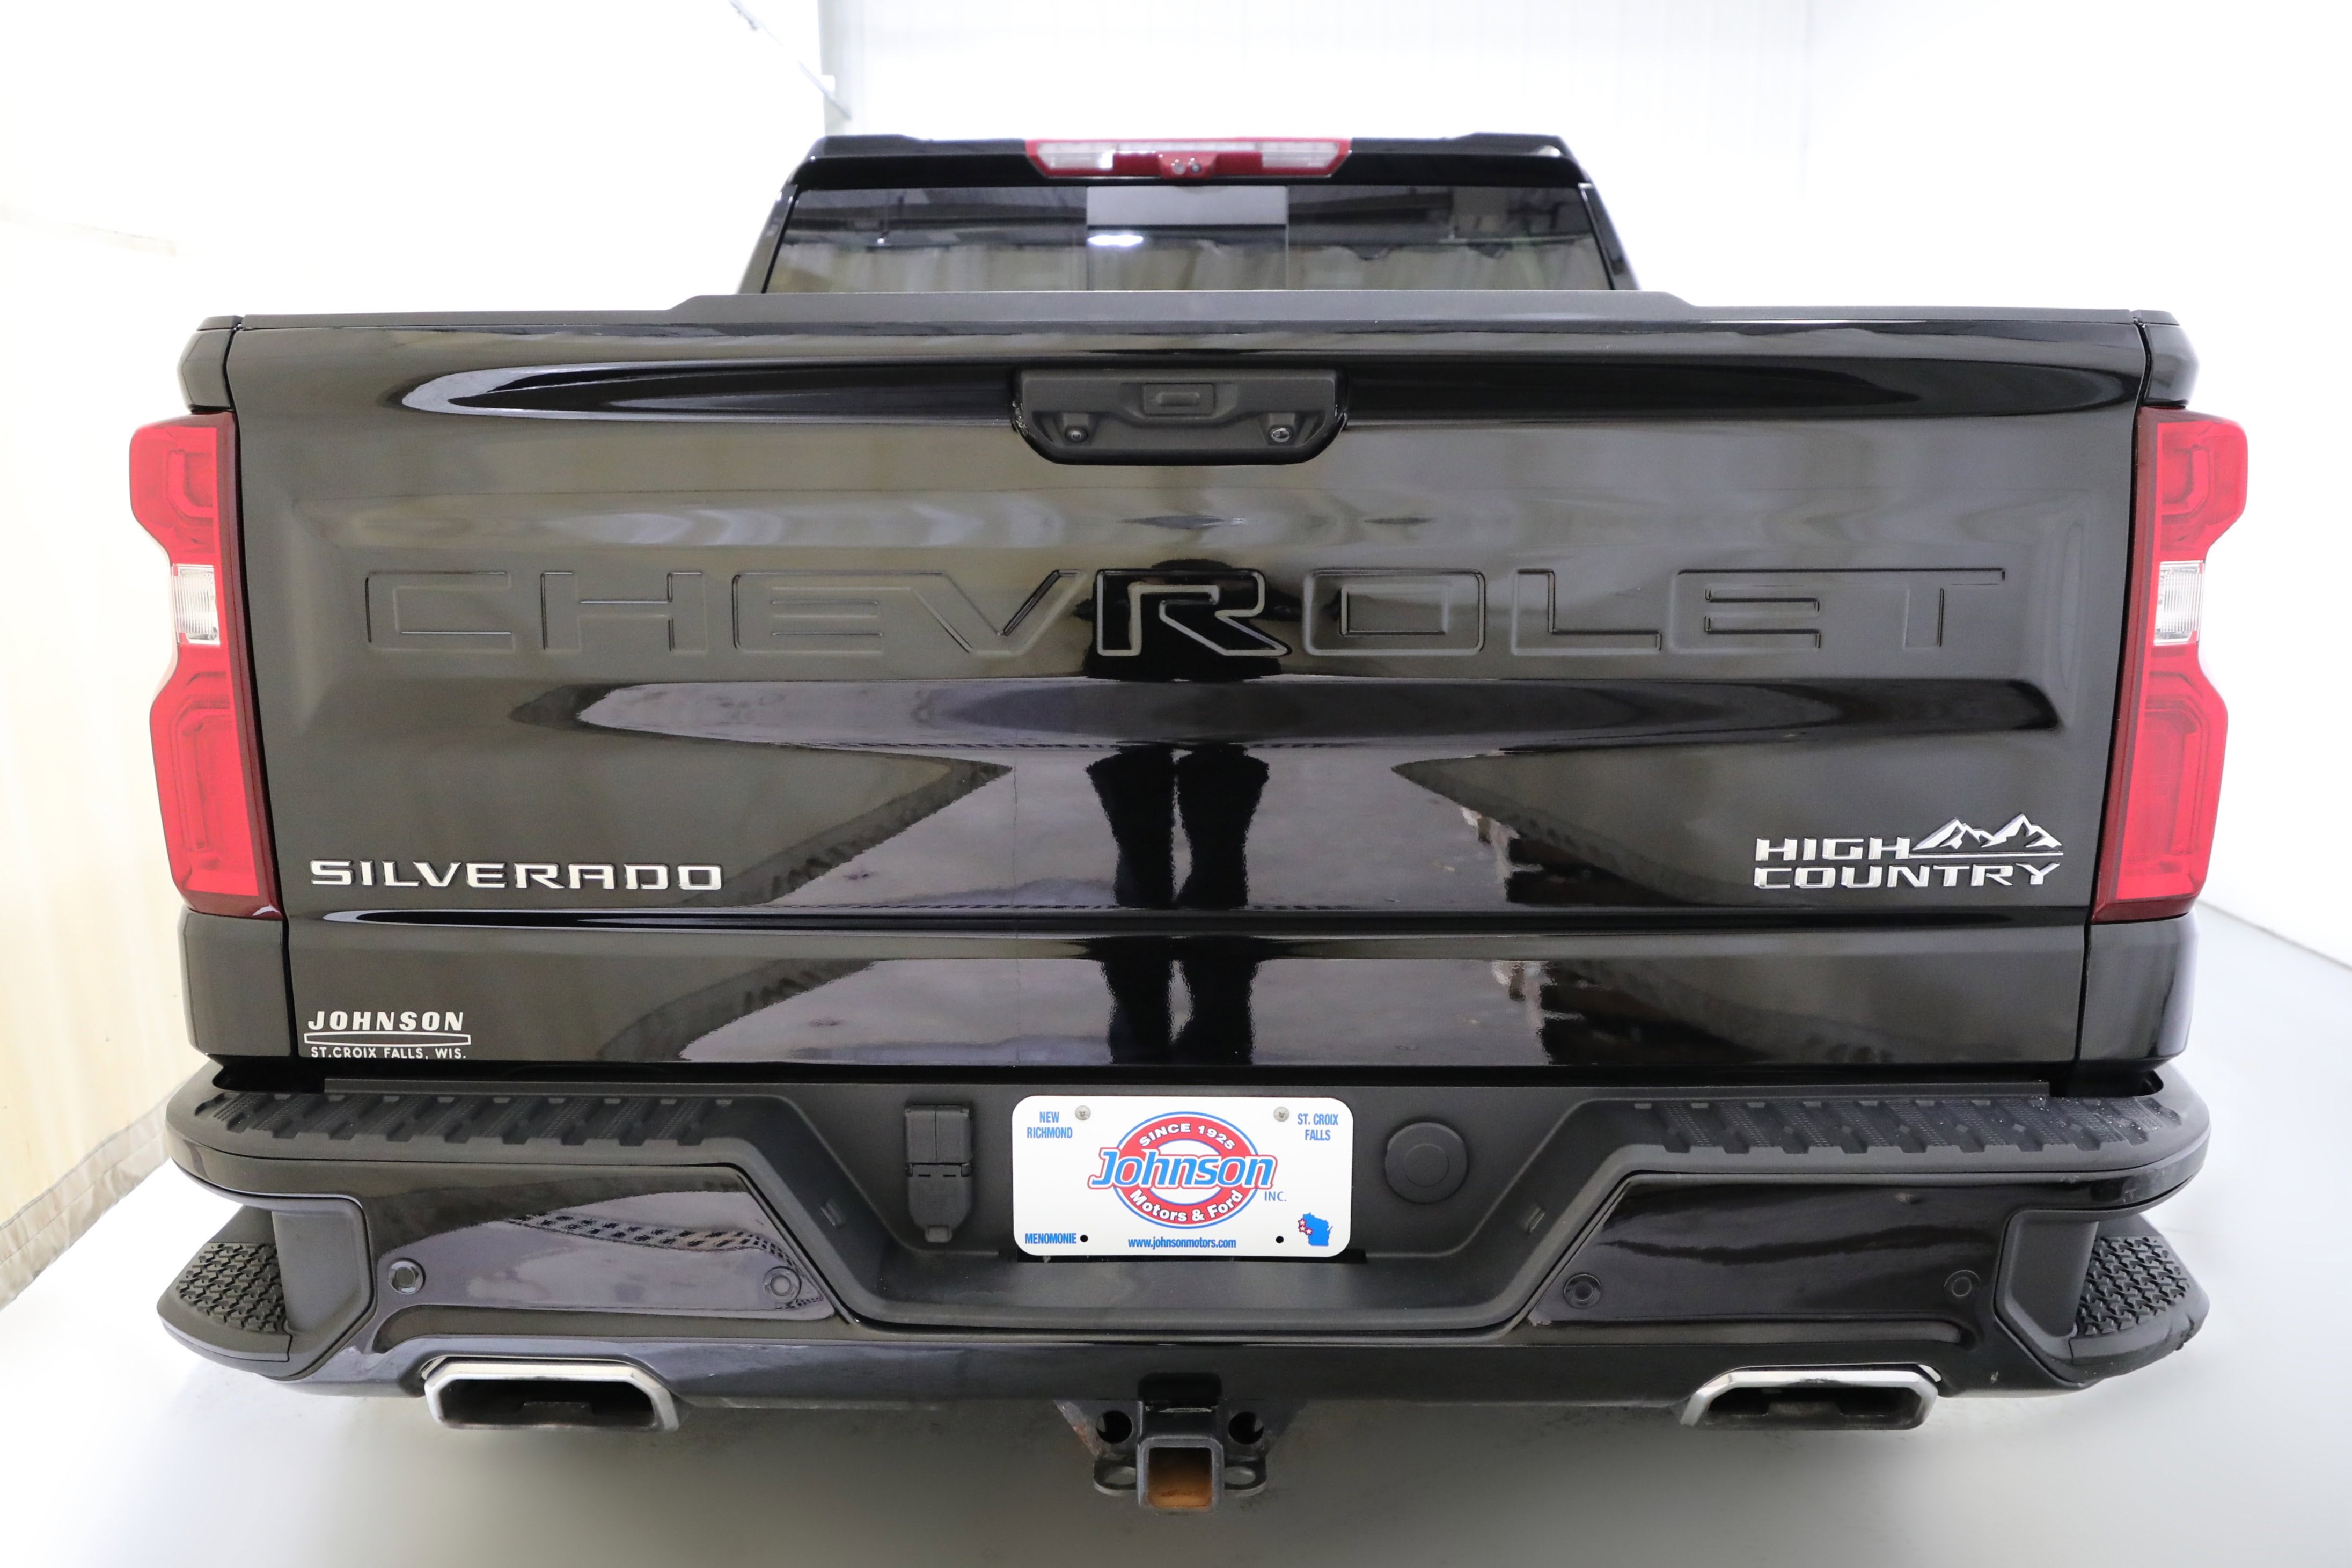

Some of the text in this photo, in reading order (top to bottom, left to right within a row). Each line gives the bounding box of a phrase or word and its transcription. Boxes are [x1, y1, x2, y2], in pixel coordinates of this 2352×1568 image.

[366, 569, 2006, 658] CHEVROLET
[1755, 837, 1911, 861] HIGH
[310, 859, 723, 890] SILVERADO
[1753, 862, 2061, 889] COUNTRY
[307, 1010, 464, 1031] JOHNSON
[384, 1047, 428, 1060] FALLS,
[435, 1048, 466, 1059] WIS.
[1039, 1111, 1060, 1123] NEW
[1297, 1113, 1339, 1125] ST. CROIX
[1027, 1126, 1073, 1139] RICHMOND
[1139, 1122, 1236, 1150] SINCE 1925
[1305, 1129, 1331, 1141] FALLS
[1089, 1147, 1276, 1189] Johnson
[1129, 1188, 1244, 1222] Motors & Ford
[1264, 1191, 1287, 1202] INC.
[1024, 1232, 1077, 1244] MENOMONIE
[1127, 1236, 1236, 1250] www.johnsonmotors.com
